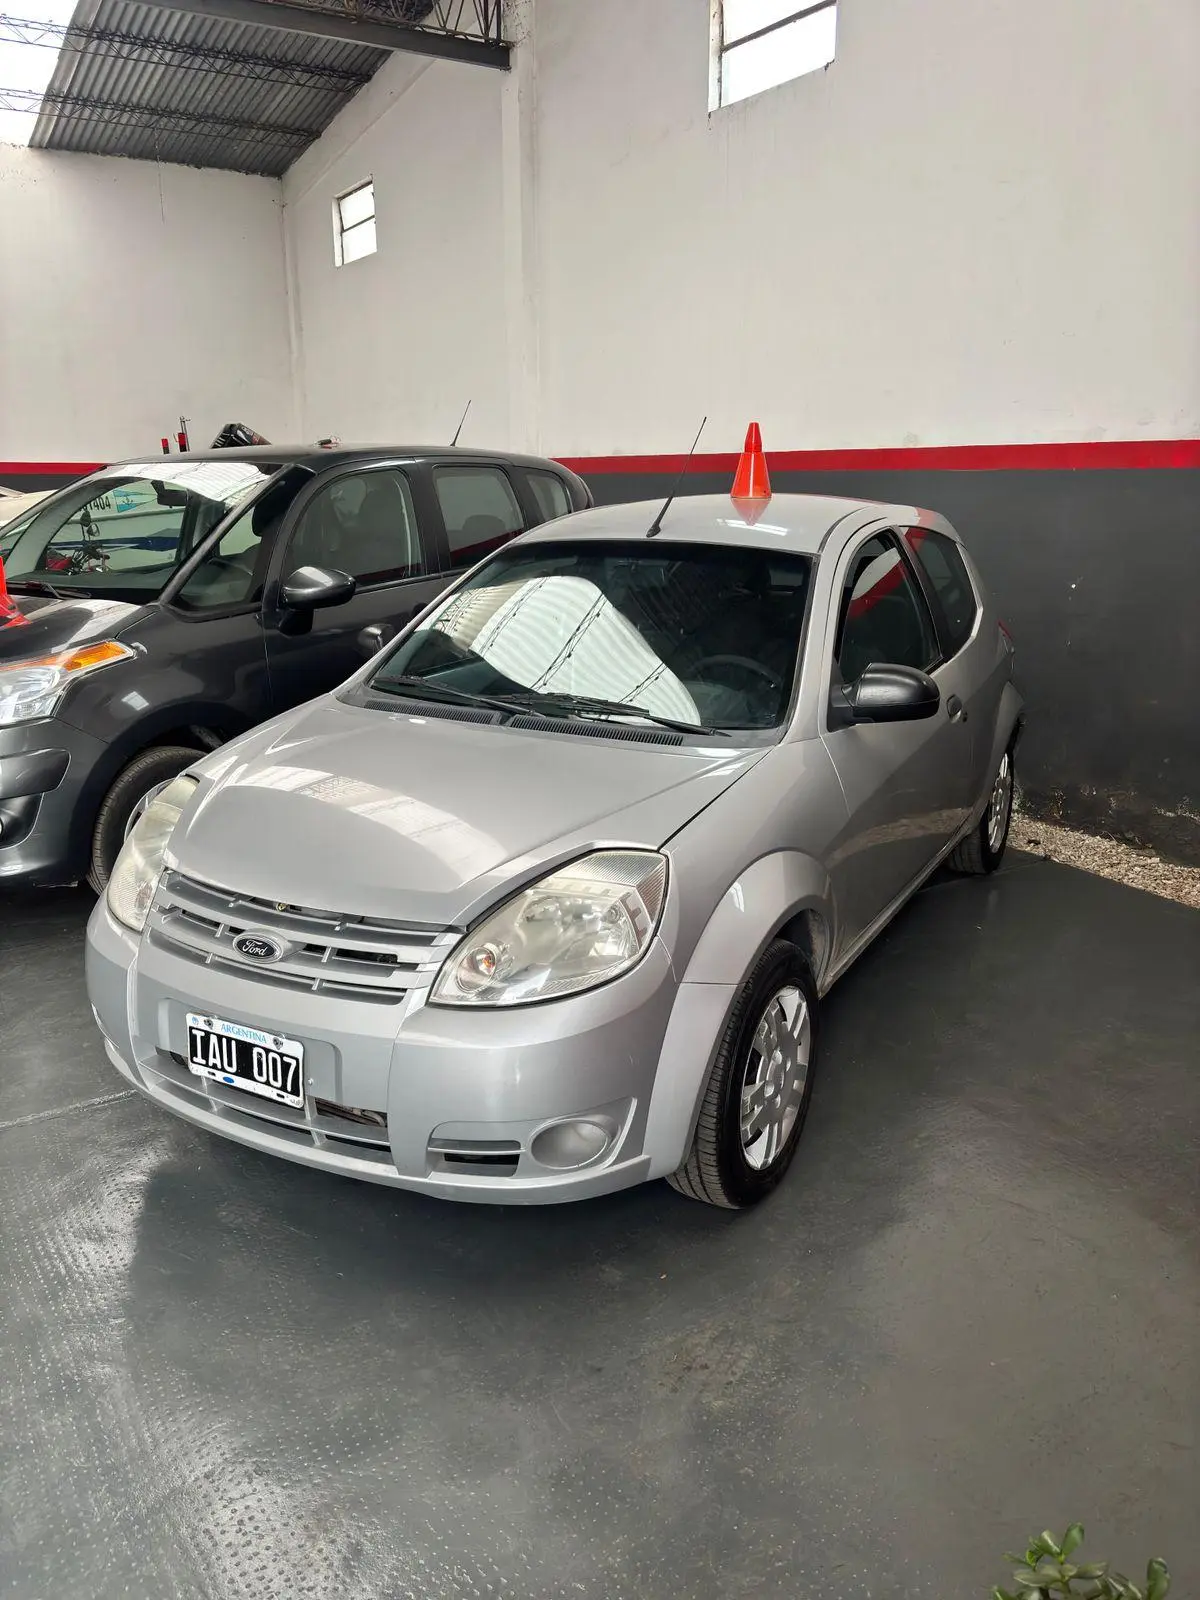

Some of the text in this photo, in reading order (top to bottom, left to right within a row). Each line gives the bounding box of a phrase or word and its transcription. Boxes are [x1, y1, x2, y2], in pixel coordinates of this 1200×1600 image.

[242, 940, 268, 956] Ford
[221, 1023, 267, 1044] ARGENTINA
[191, 1029, 297, 1092] IAU 007
